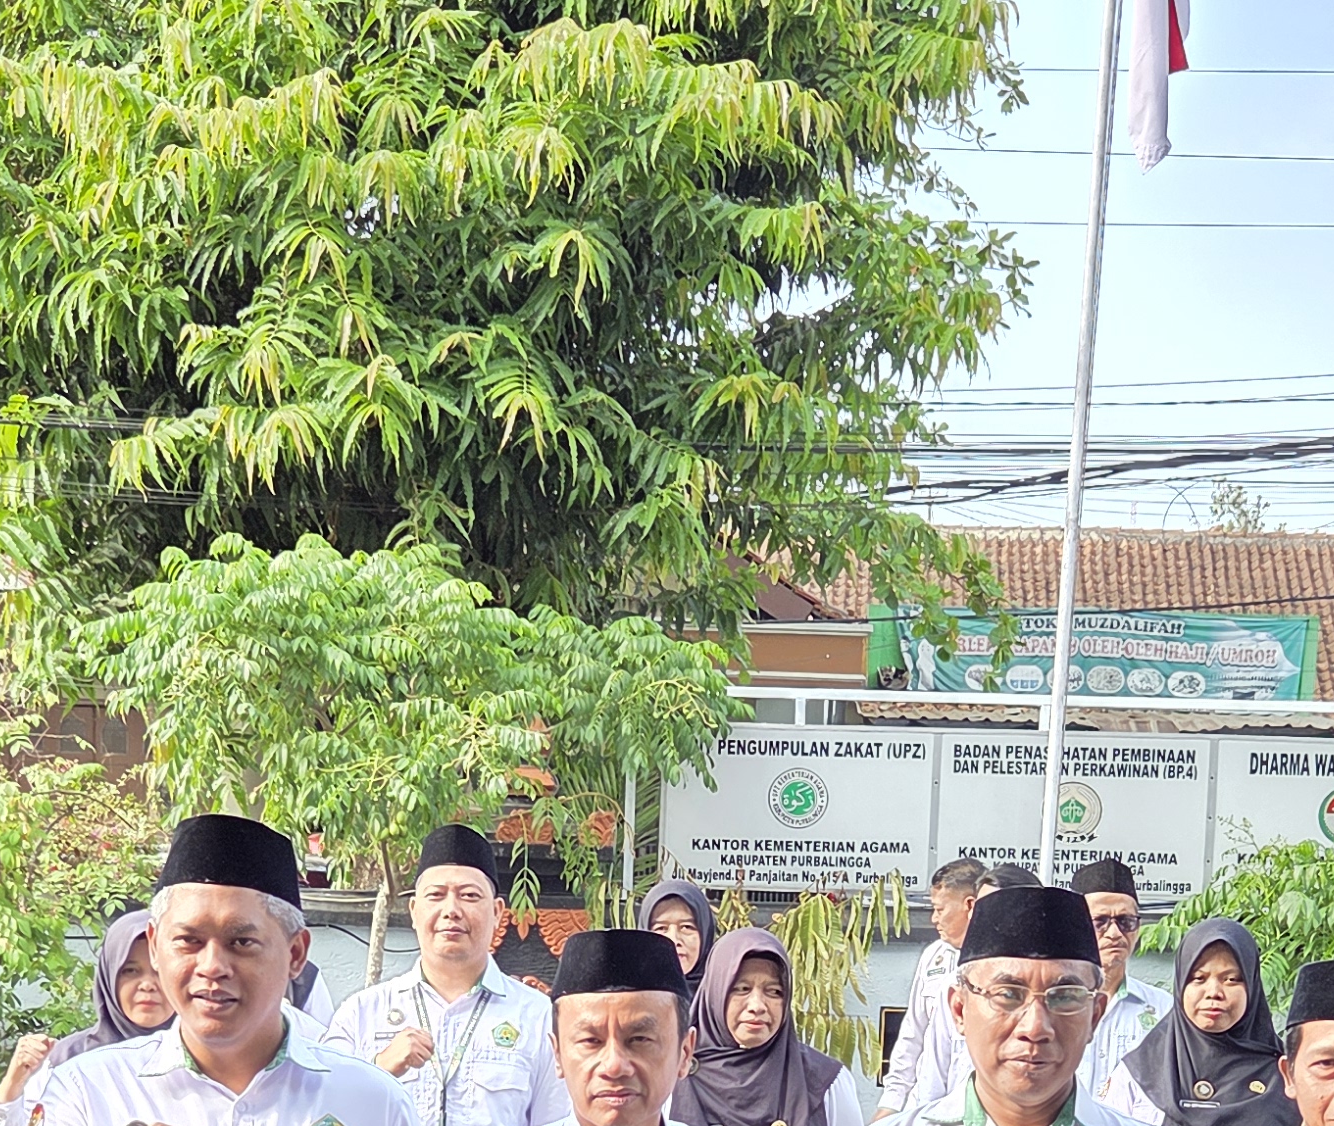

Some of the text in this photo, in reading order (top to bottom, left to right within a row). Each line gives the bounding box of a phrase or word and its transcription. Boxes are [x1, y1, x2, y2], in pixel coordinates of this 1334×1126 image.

[1023, 617, 1056, 629] TOK
[1168, 643, 1205, 660] HAJI
[1220, 647, 1277, 665] UMROH
[718, 739, 829, 757] PENGUMPULAN
[834, 742, 884, 759] ZAKAT
[887, 743, 926, 760] (UPZ)
[954, 744, 1196, 764] BADAN PENASHATAN PEMBINAAN
[953, 760, 1198, 781] DAN PELESTARN PERKAWINAN (BP.4)
[1249, 752, 1310, 776] DHARMA
[692, 839, 910, 854] KANTOR KEMENTERIAN AGAMA
[721, 854, 871, 868] KABUPATEN PURBALINGGA
[959, 847, 1178, 865] KANTOR KEENTERIAN AGAMA
[749, 870, 798, 884] Panjaitan
[855, 872, 918, 887] Purbalgga
[1135, 880, 1191, 895] urbalingga
